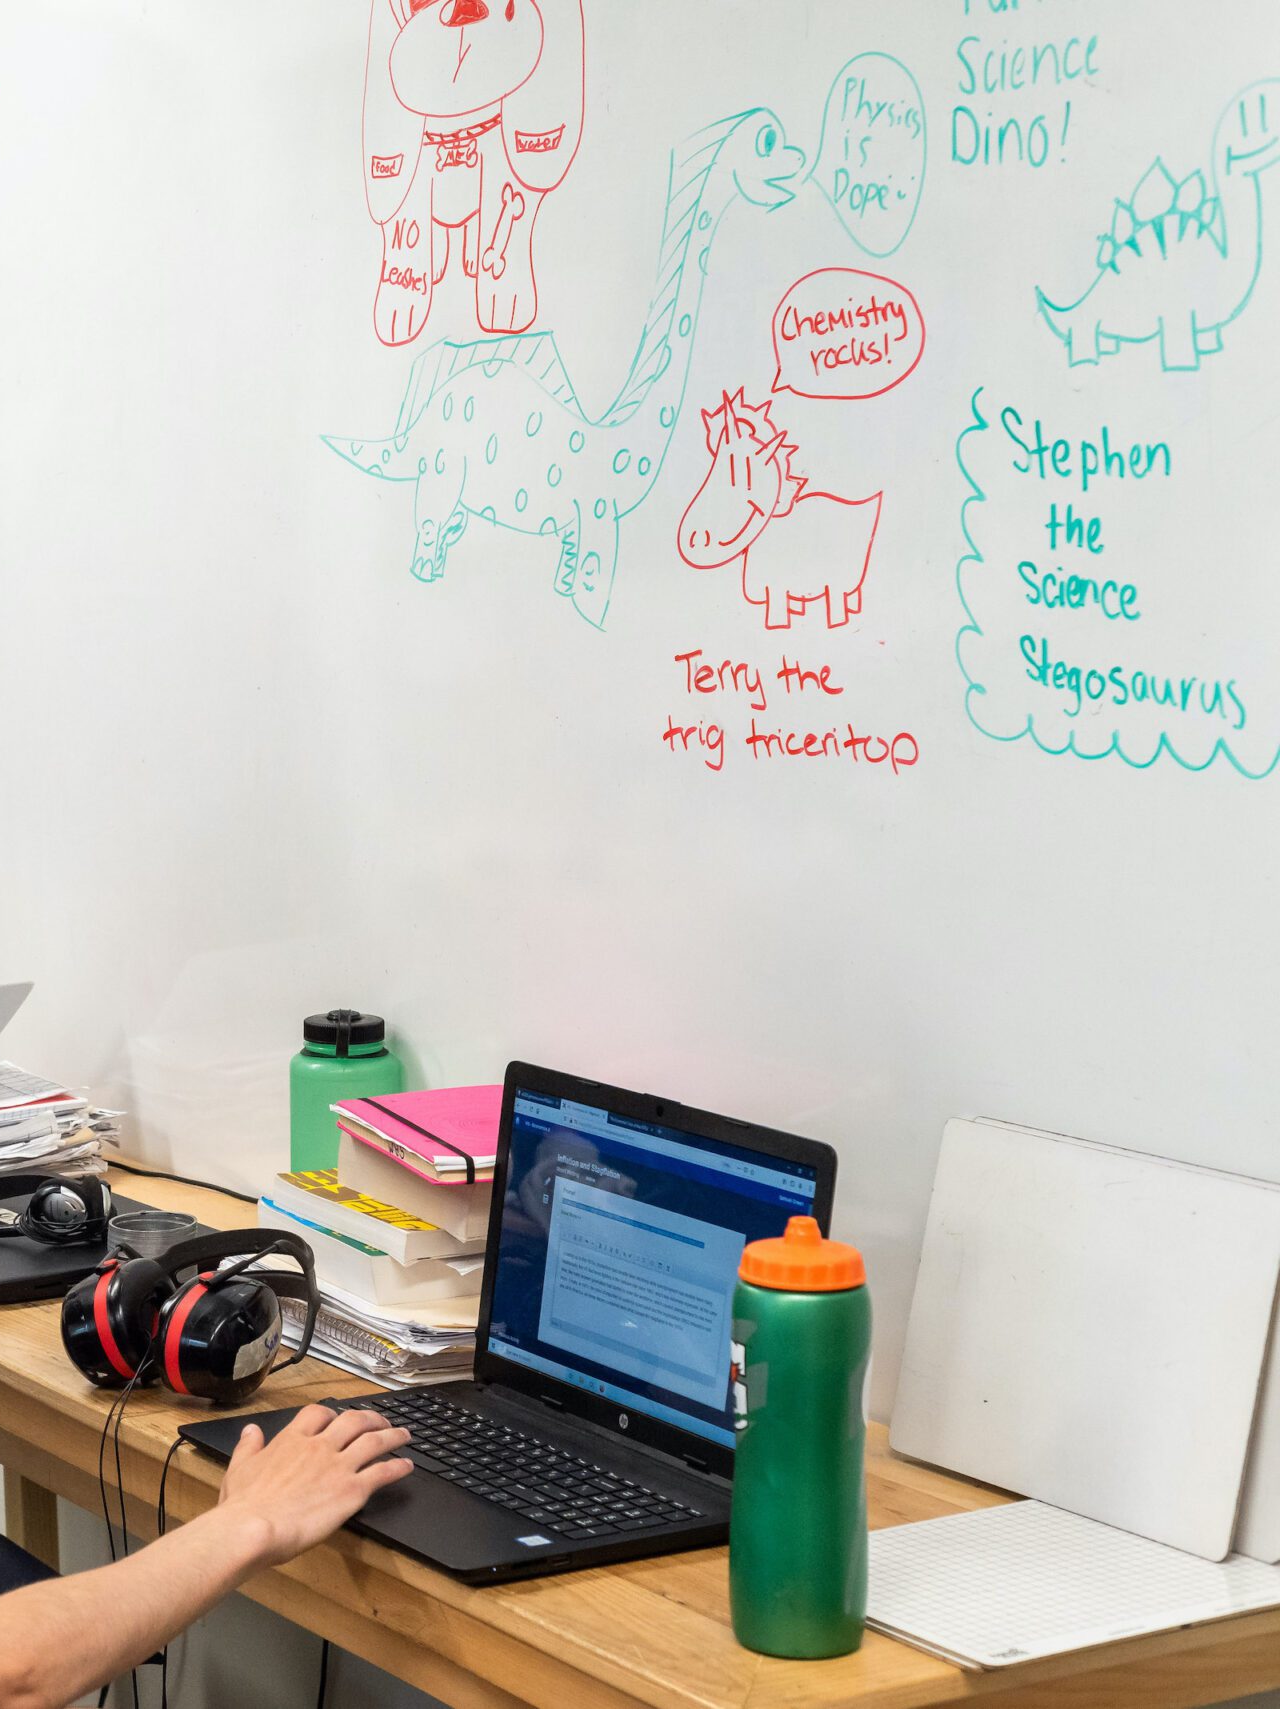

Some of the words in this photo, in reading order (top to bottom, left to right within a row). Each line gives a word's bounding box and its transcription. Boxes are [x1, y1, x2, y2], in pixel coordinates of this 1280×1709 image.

[956, 34, 1100, 95] Science
[841, 76, 921, 140] Physics
[951, 100, 1071, 168] Dino!
[843, 128, 873, 168] is
[833, 167, 890, 219] Dope
[391, 218, 421, 251] NO
[781, 295, 908, 342] Chemistry
[1000, 406, 1171, 492] Stephen
[1044, 502, 1105, 555] the
[1016, 560, 1142, 621] Science
[674, 648, 767, 711] Terry
[776, 654, 845, 695] the
[1019, 633, 1247, 731] Stegosaurus
[662, 714, 725, 772] trig
[745, 717, 920, 776] triceritop
[557, 1153, 580, 1169] Inflation
[580, 1160, 591, 1171] and
[591, 1163, 621, 1180] Stagflation
